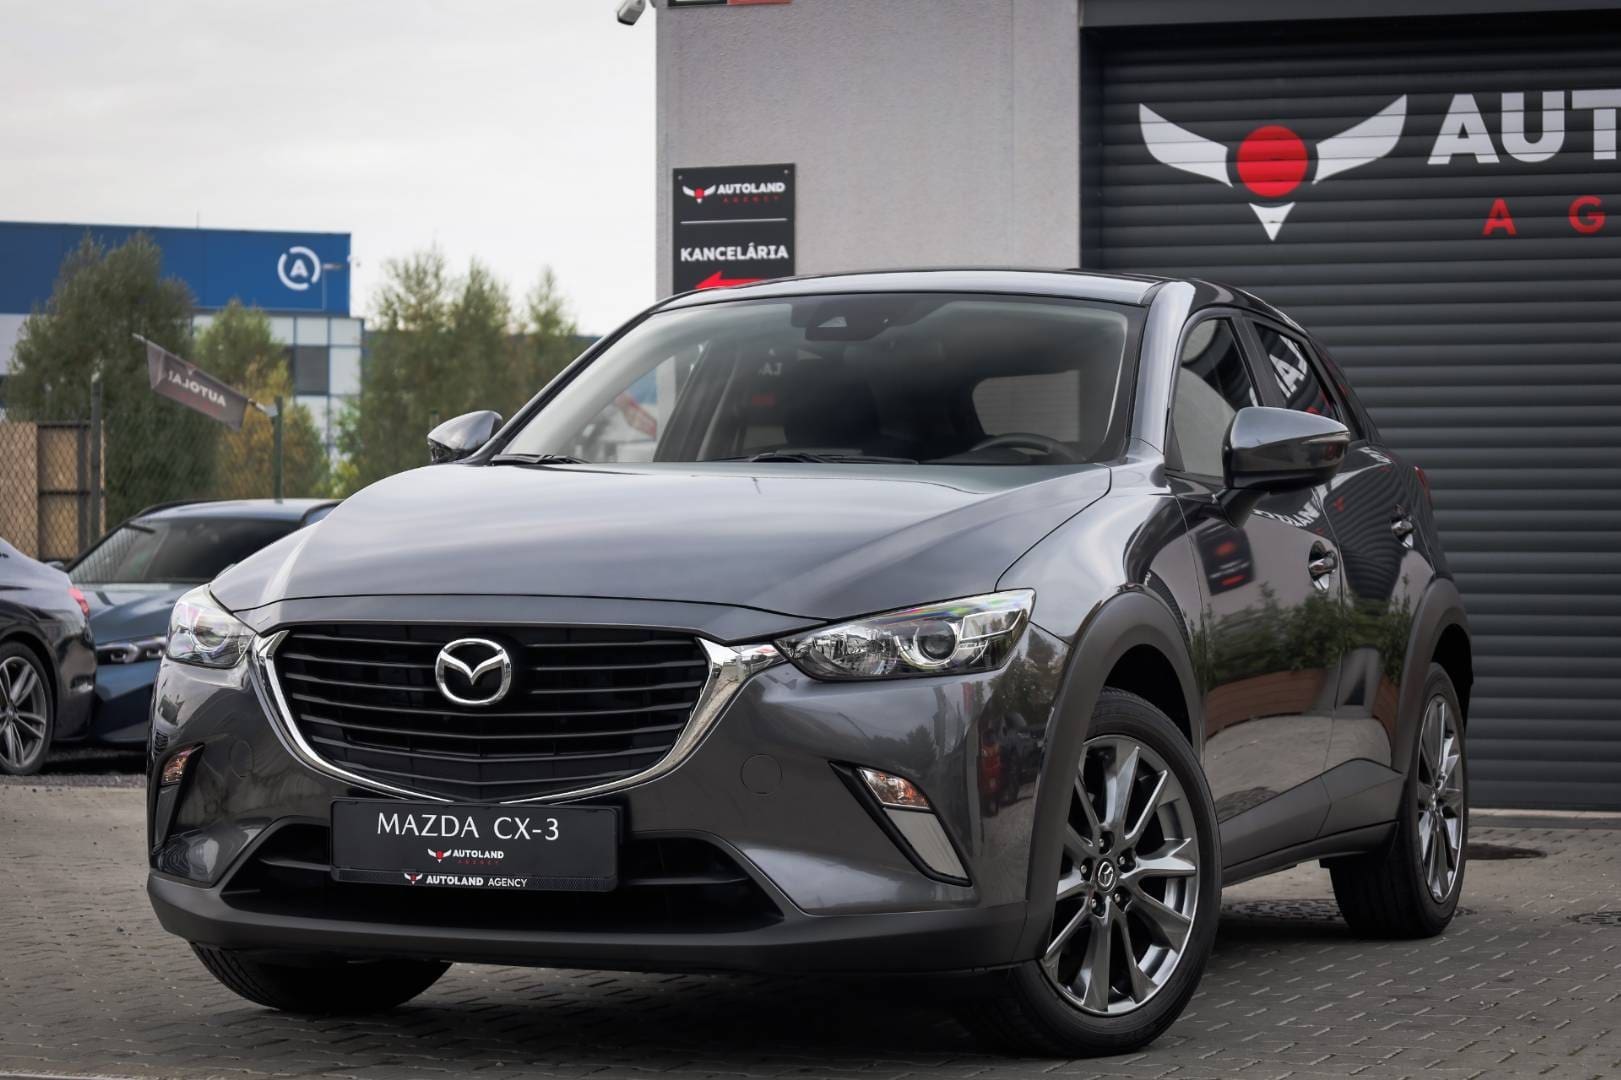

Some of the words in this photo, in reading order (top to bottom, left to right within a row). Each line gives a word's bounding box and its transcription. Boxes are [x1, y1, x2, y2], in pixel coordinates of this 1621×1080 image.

[717, 182, 786, 195] AUTOLAND
[680, 242, 789, 262] KANCELÁRIA
[376, 811, 480, 838] MAZDA
[493, 816, 560, 841] CX-3
[452, 849, 504, 859] AUTOLAND
[425, 875, 484, 887] AUTOLAND
[487, 878, 528, 888] AGENCY
